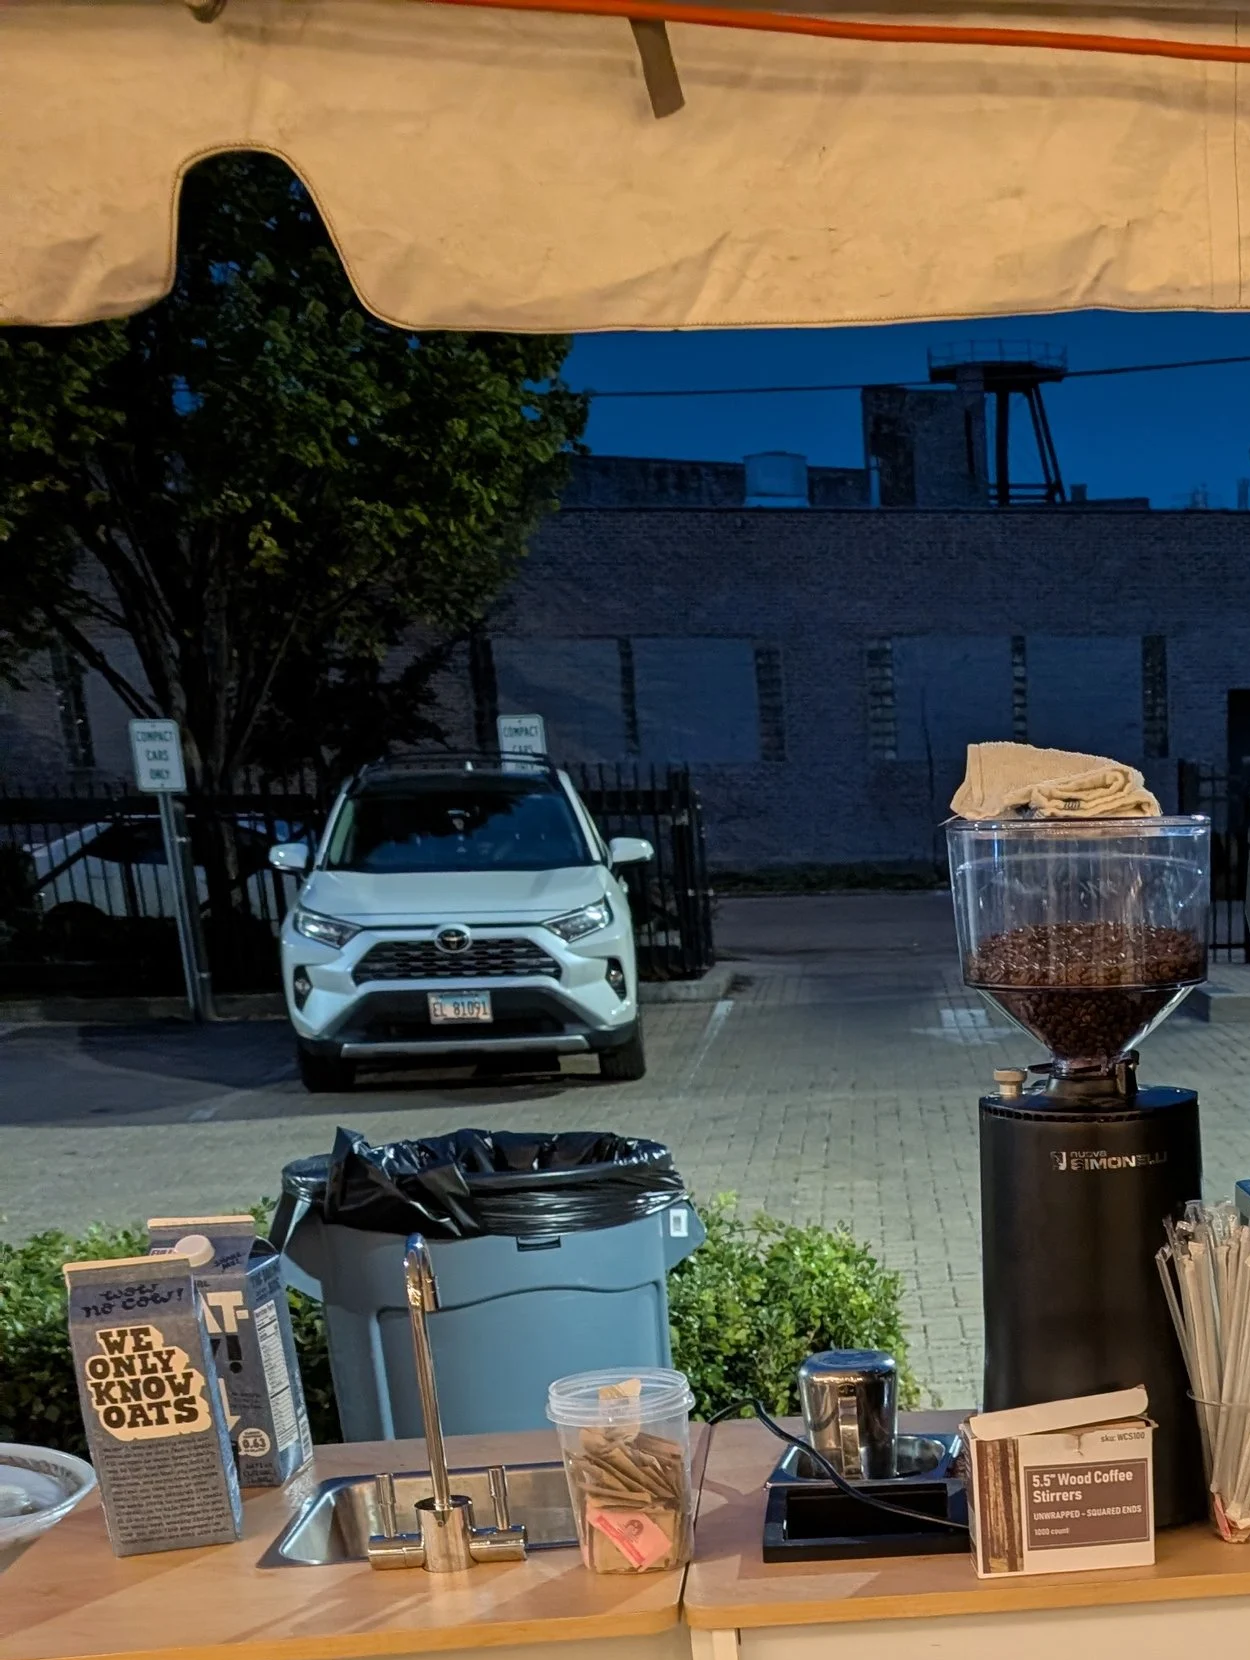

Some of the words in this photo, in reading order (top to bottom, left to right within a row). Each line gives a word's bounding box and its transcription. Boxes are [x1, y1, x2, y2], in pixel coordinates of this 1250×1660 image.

[136, 731, 173, 742] COMPACT
[504, 726, 538, 737] COMPACT
[146, 750, 169, 762] CARS
[82, 1304, 116, 1318] no
[121, 1288, 184, 1310] cow!
[99, 1327, 153, 1355] WE
[88, 1349, 175, 1380] ONLY
[90, 1372, 193, 1406] KNOW
[103, 1396, 199, 1429] OATS
[242, 1437, 267, 1449] 0.63
[1058, 1472, 1091, 1486] Wood
[1094, 1469, 1134, 1484] Coffee
[1033, 1490, 1082, 1504] Stirrers
[1033, 1510, 1080, 1521] UNWRAPPED
[1086, 1507, 1121, 1518] SQUARED
[1122, 1505, 1142, 1514] ENDS
[1034, 1528, 1050, 1536] 1000
[1050, 1527, 1069, 1536] count
